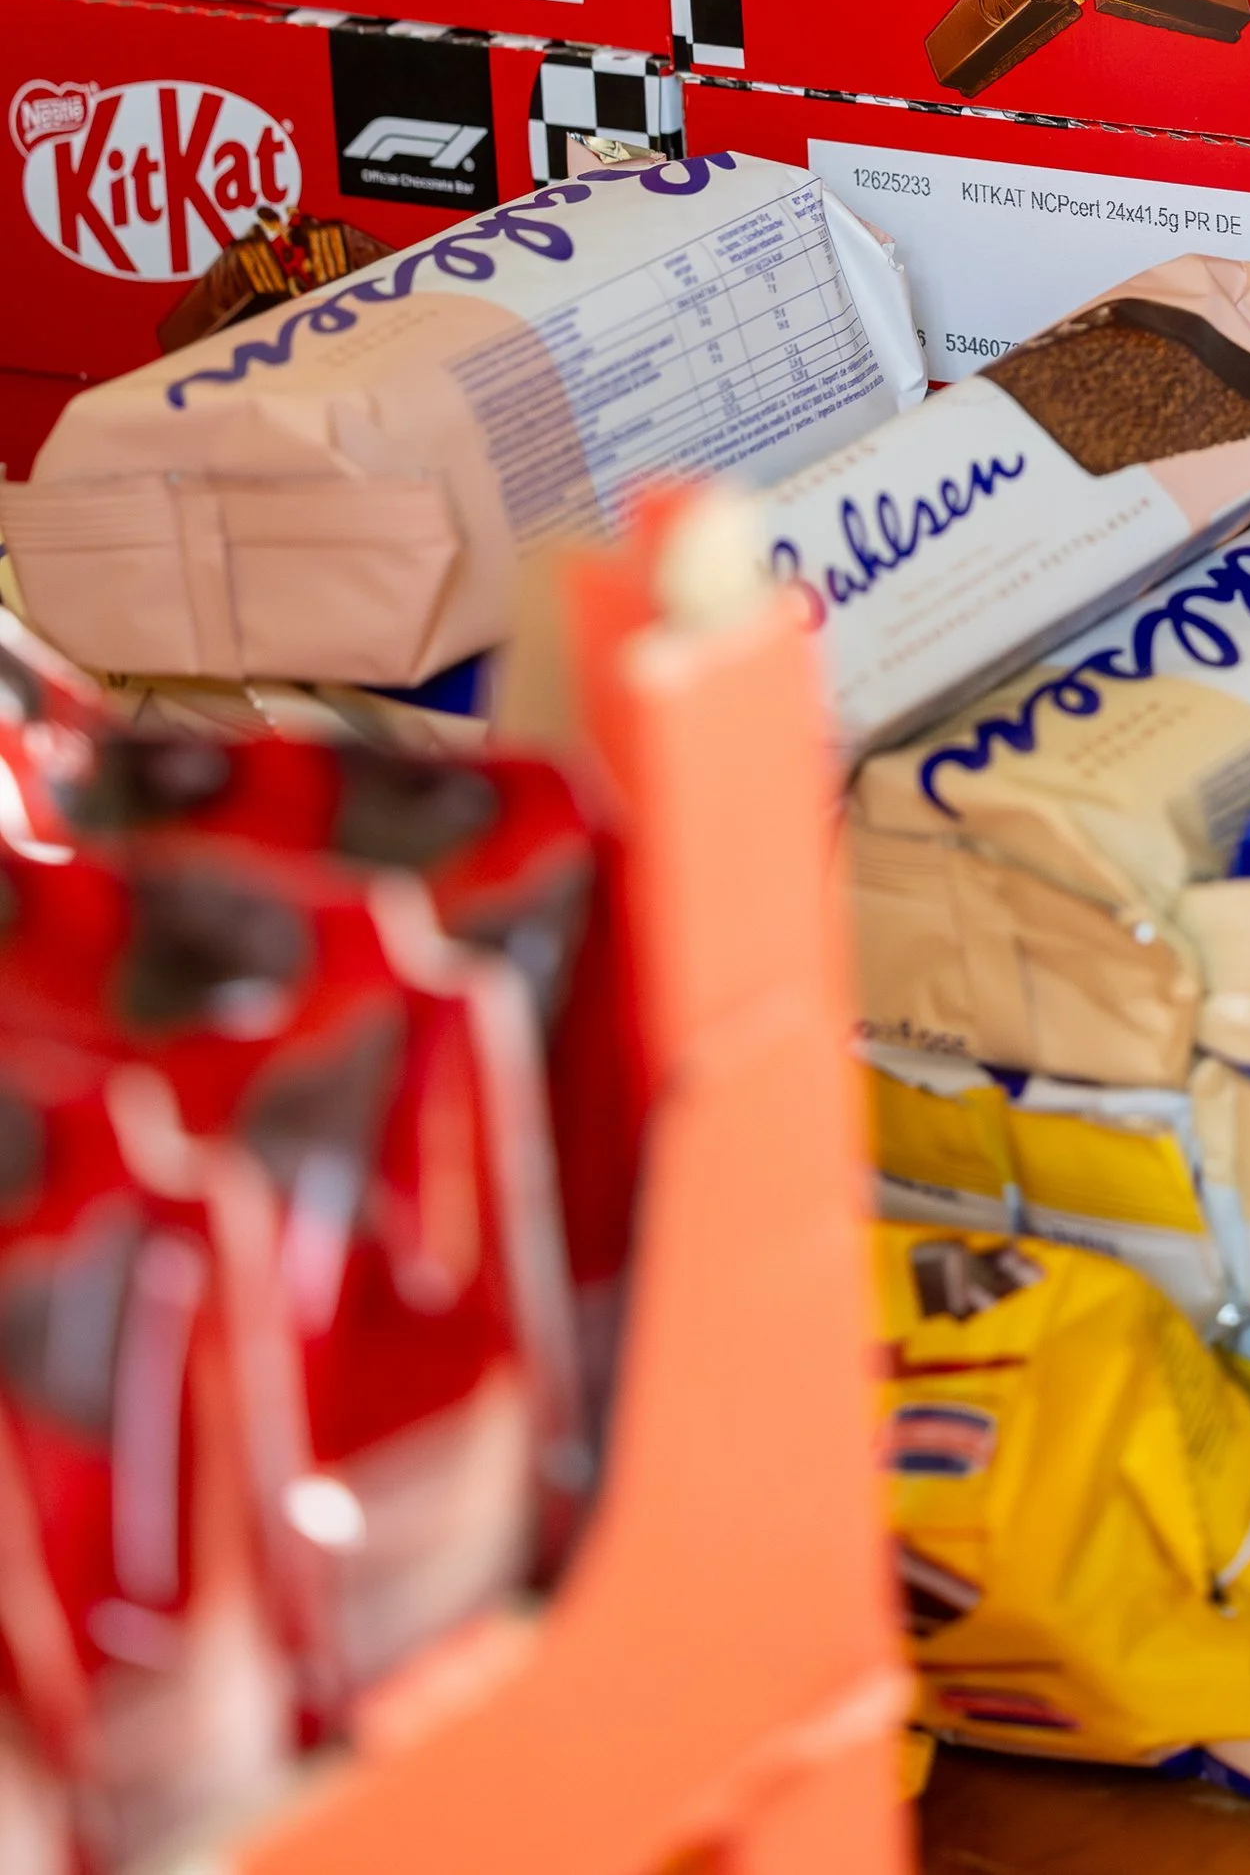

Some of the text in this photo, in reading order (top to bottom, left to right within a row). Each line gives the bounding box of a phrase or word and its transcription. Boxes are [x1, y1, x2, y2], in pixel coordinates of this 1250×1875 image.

[53, 88, 289, 273] KitKat
[853, 168, 1243, 235] 12625233 KITKAT NCPcert 24x41.5g PR DE
